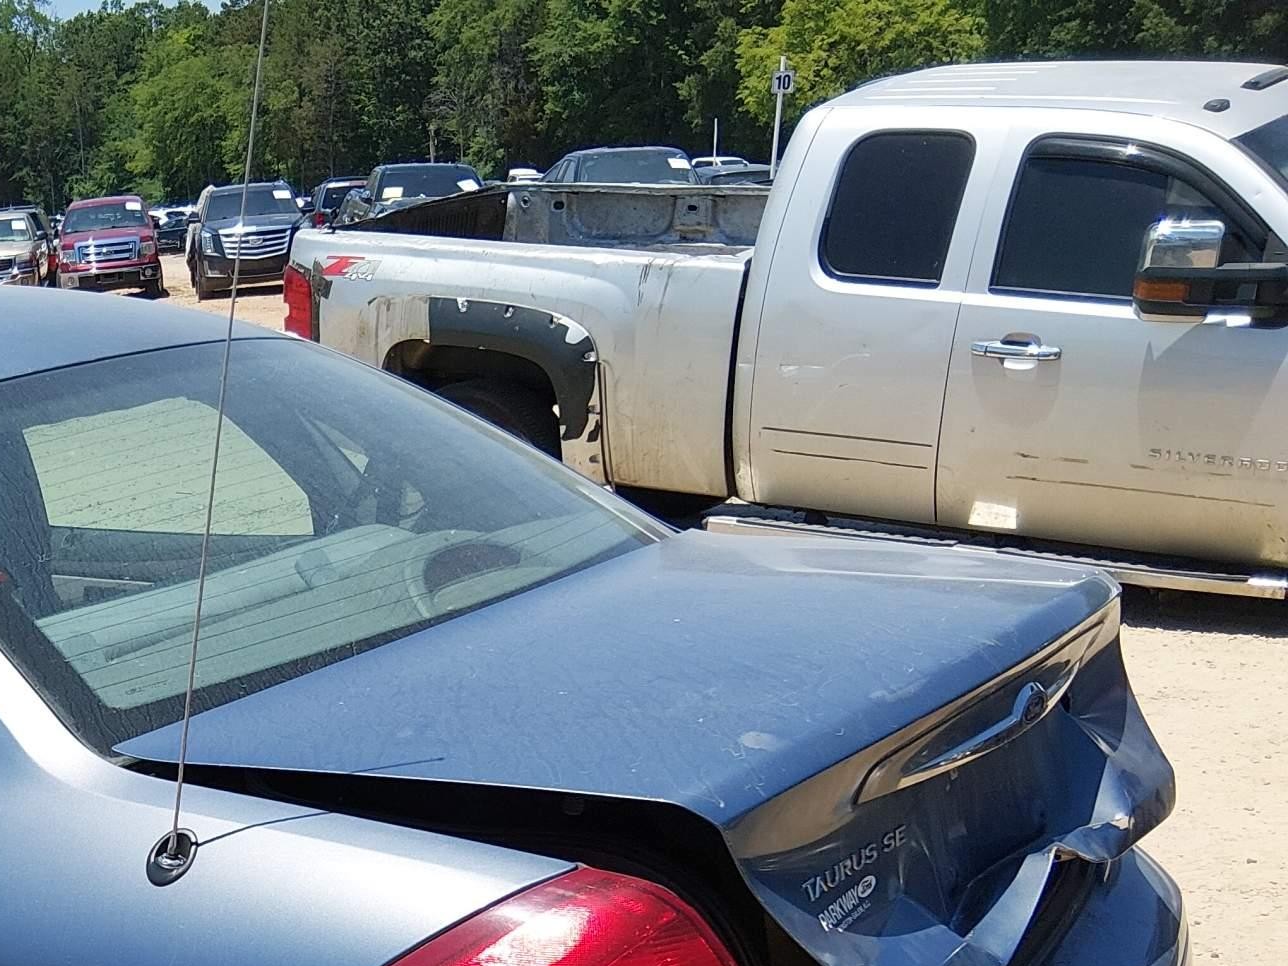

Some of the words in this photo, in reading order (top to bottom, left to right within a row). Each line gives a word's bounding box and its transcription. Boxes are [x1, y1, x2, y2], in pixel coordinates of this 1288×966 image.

[775, 74, 791, 90] 10
[802, 843, 878, 902] TAURUS
[882, 825, 908, 852] SE
[818, 885, 859, 932] PARKWAY
